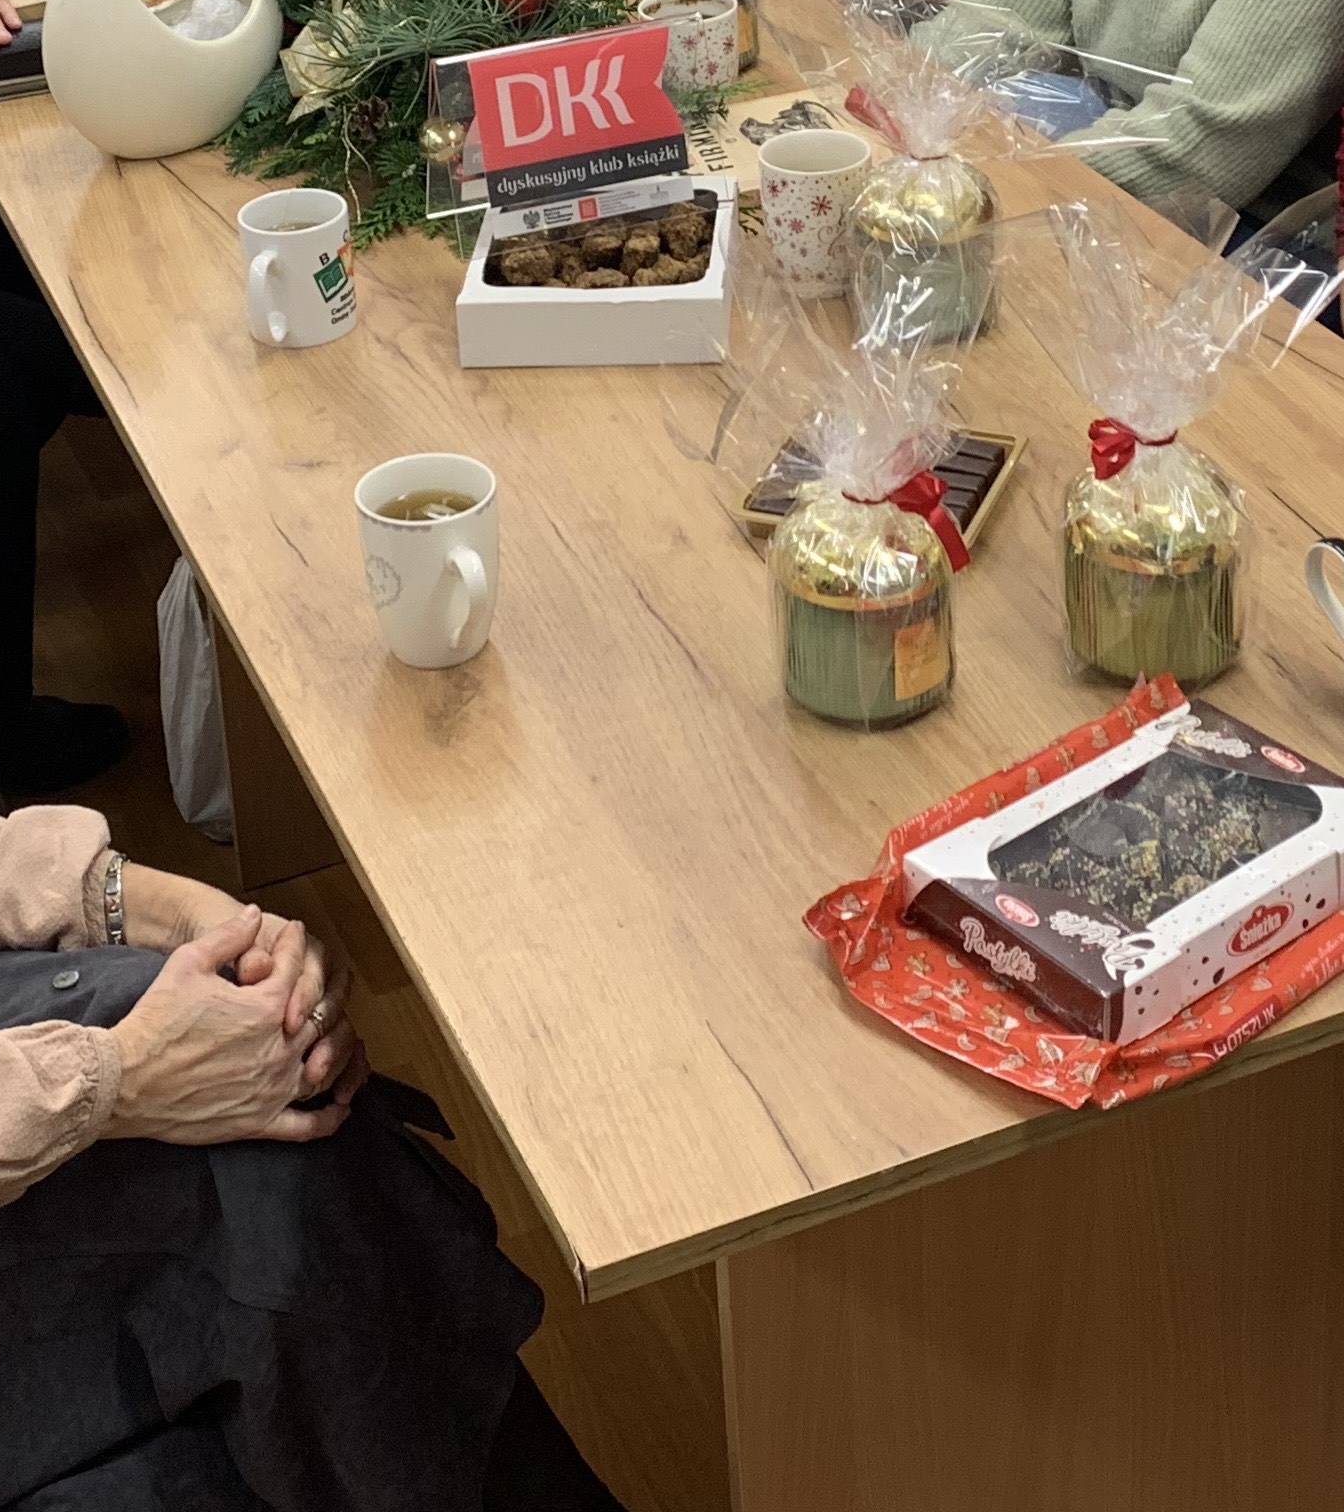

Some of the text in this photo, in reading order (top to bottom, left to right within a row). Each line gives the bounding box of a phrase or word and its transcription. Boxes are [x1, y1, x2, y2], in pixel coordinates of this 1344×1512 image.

[497, 144, 680, 196] dyskusyjny klub książki
[319, 252, 330, 266] B
